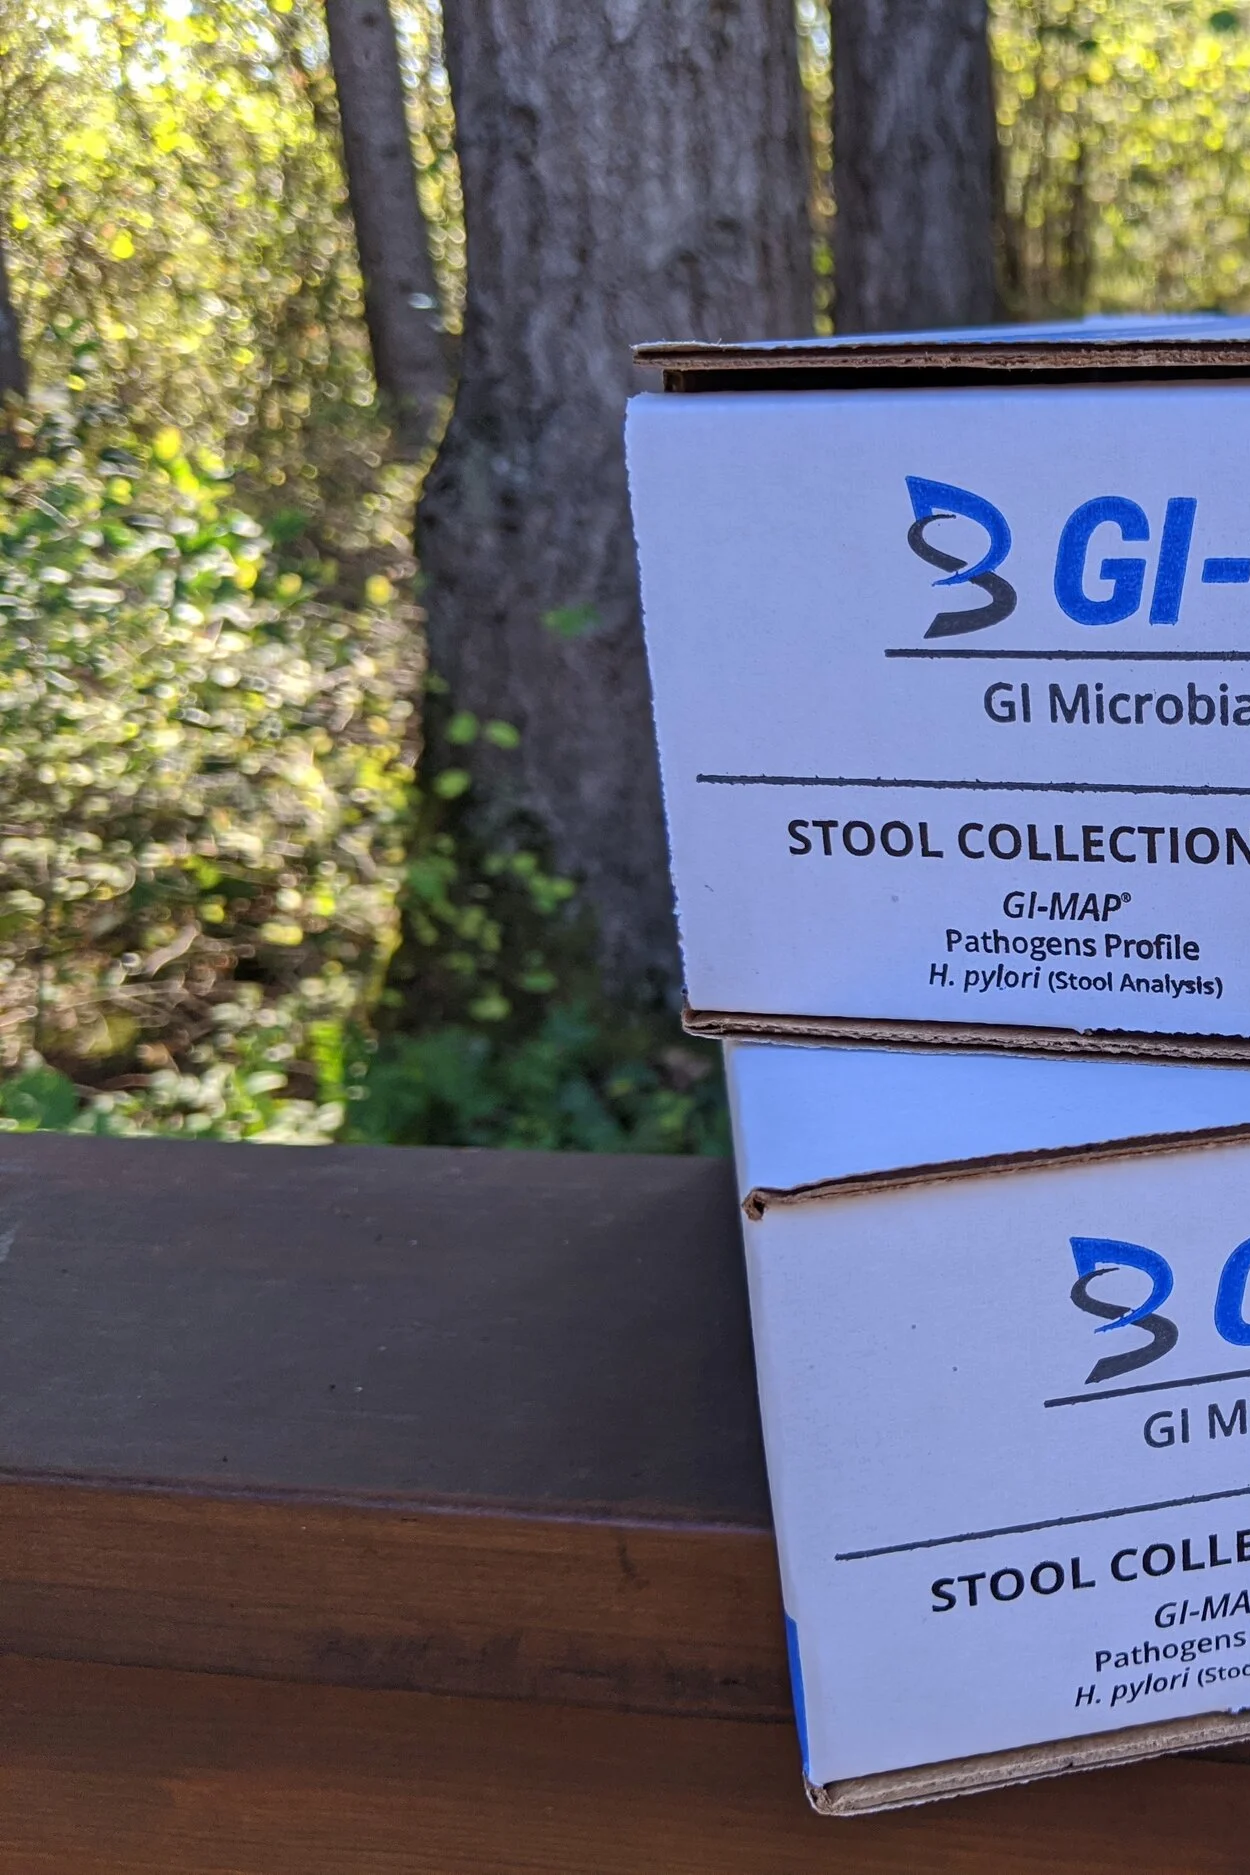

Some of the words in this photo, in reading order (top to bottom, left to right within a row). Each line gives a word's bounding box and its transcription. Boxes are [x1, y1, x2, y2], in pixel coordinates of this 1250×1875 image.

[984, 682, 1031, 723] GI
[788, 820, 943, 858] STOOL
[945, 929, 1097, 959] Pathogens
[1105, 934, 1199, 961] Profile
[929, 963, 954, 987] H.
[964, 963, 1041, 993] pylori
[1047, 972, 1113, 994] (Stool
[1121, 973, 1224, 1000] Analysis)
[1144, 1408, 1189, 1448] GI
[931, 1557, 1096, 1612] STOOL
[1095, 1629, 1246, 1673] Pathogens
[1075, 1684, 1101, 1707] H.
[1110, 1667, 1190, 1707] pylori
